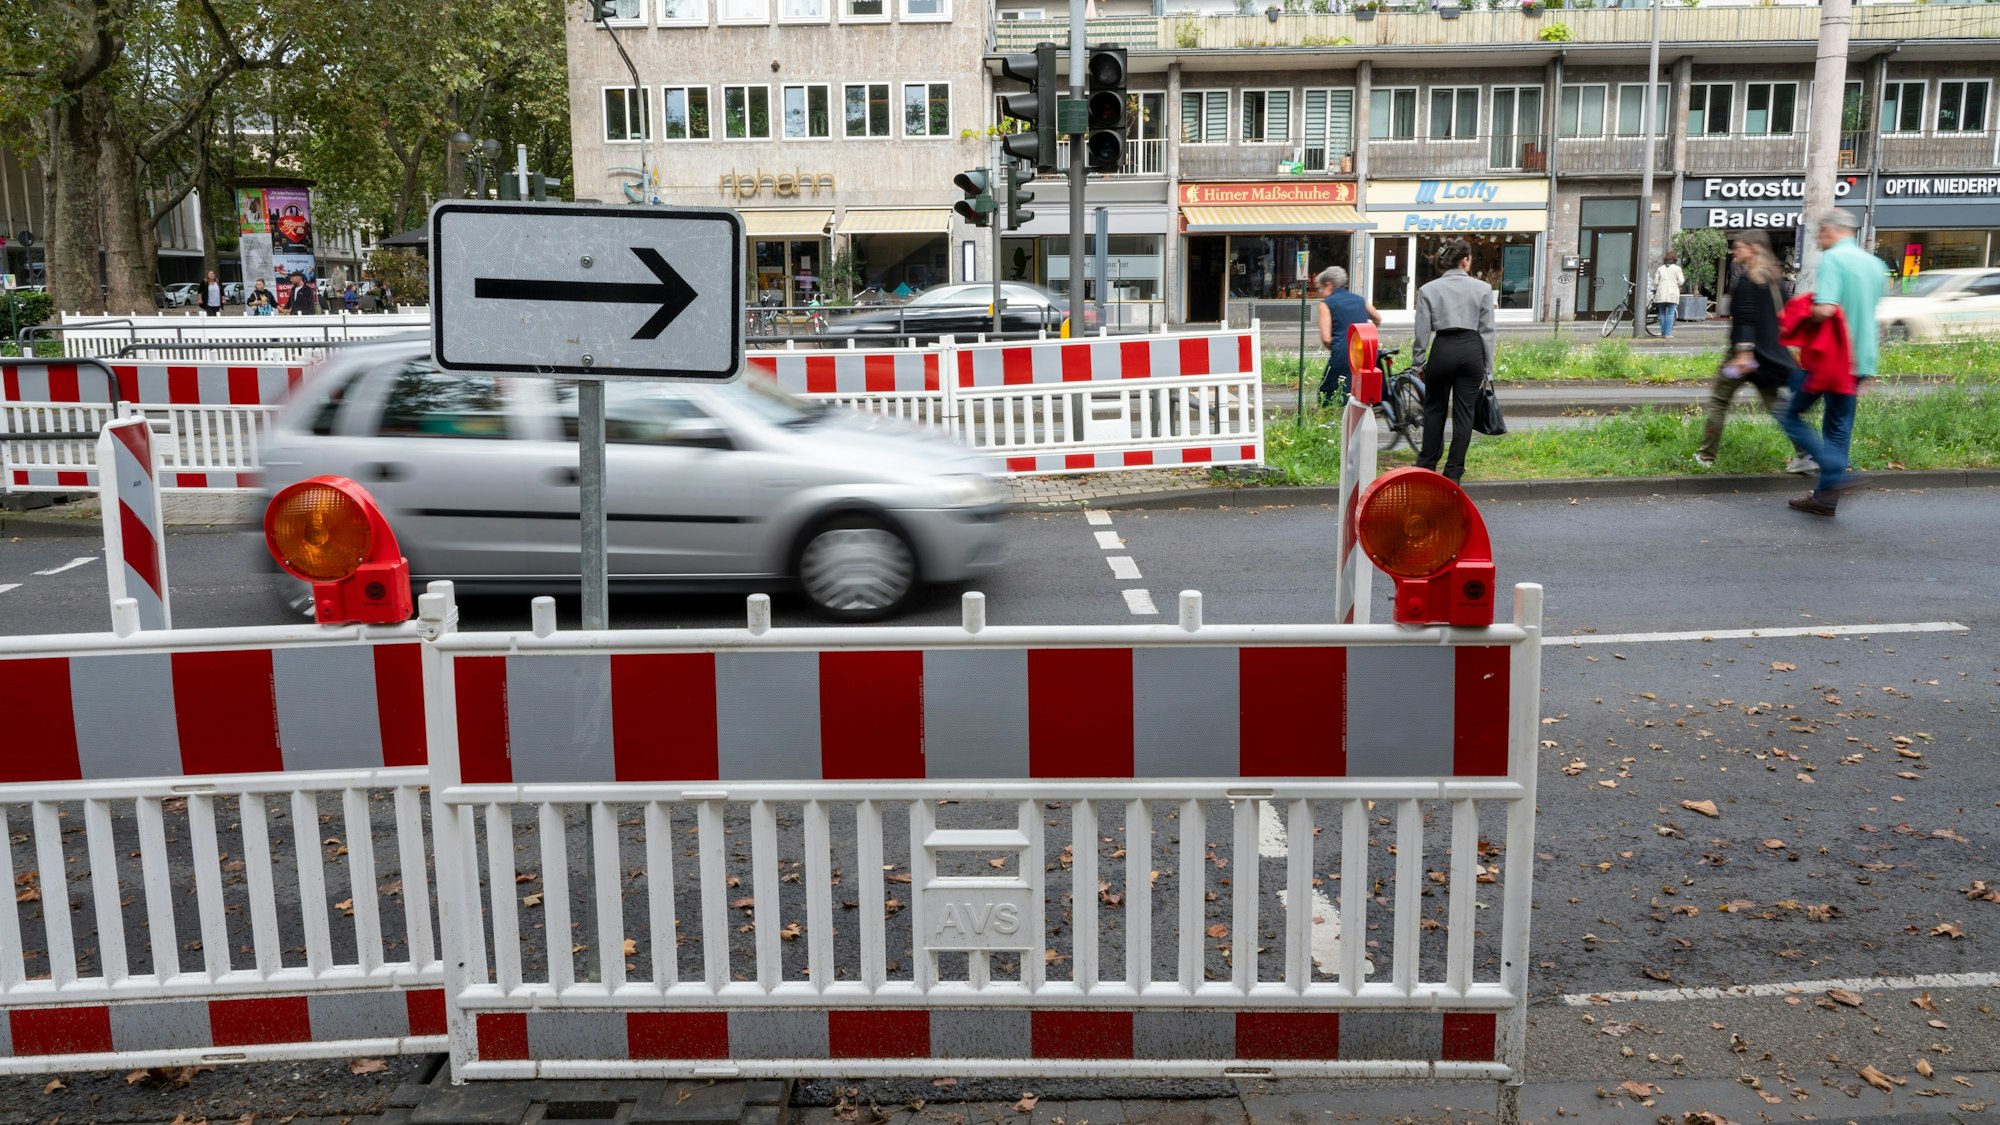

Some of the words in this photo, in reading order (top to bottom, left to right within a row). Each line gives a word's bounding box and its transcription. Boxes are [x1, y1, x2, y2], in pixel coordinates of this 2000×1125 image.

[1203, 187, 1249, 202] Himer
[1251, 185, 1331, 201] Maßschuhe
[1441, 180, 1500, 203] Lofty
[1704, 177, 1851, 199] Fotostuo
[1885, 178, 1930, 194] OPTIK
[1933, 177, 2000, 194] NIEDERP
[1403, 213, 1509, 231] Perücken
[935, 901, 1020, 935] AVS
